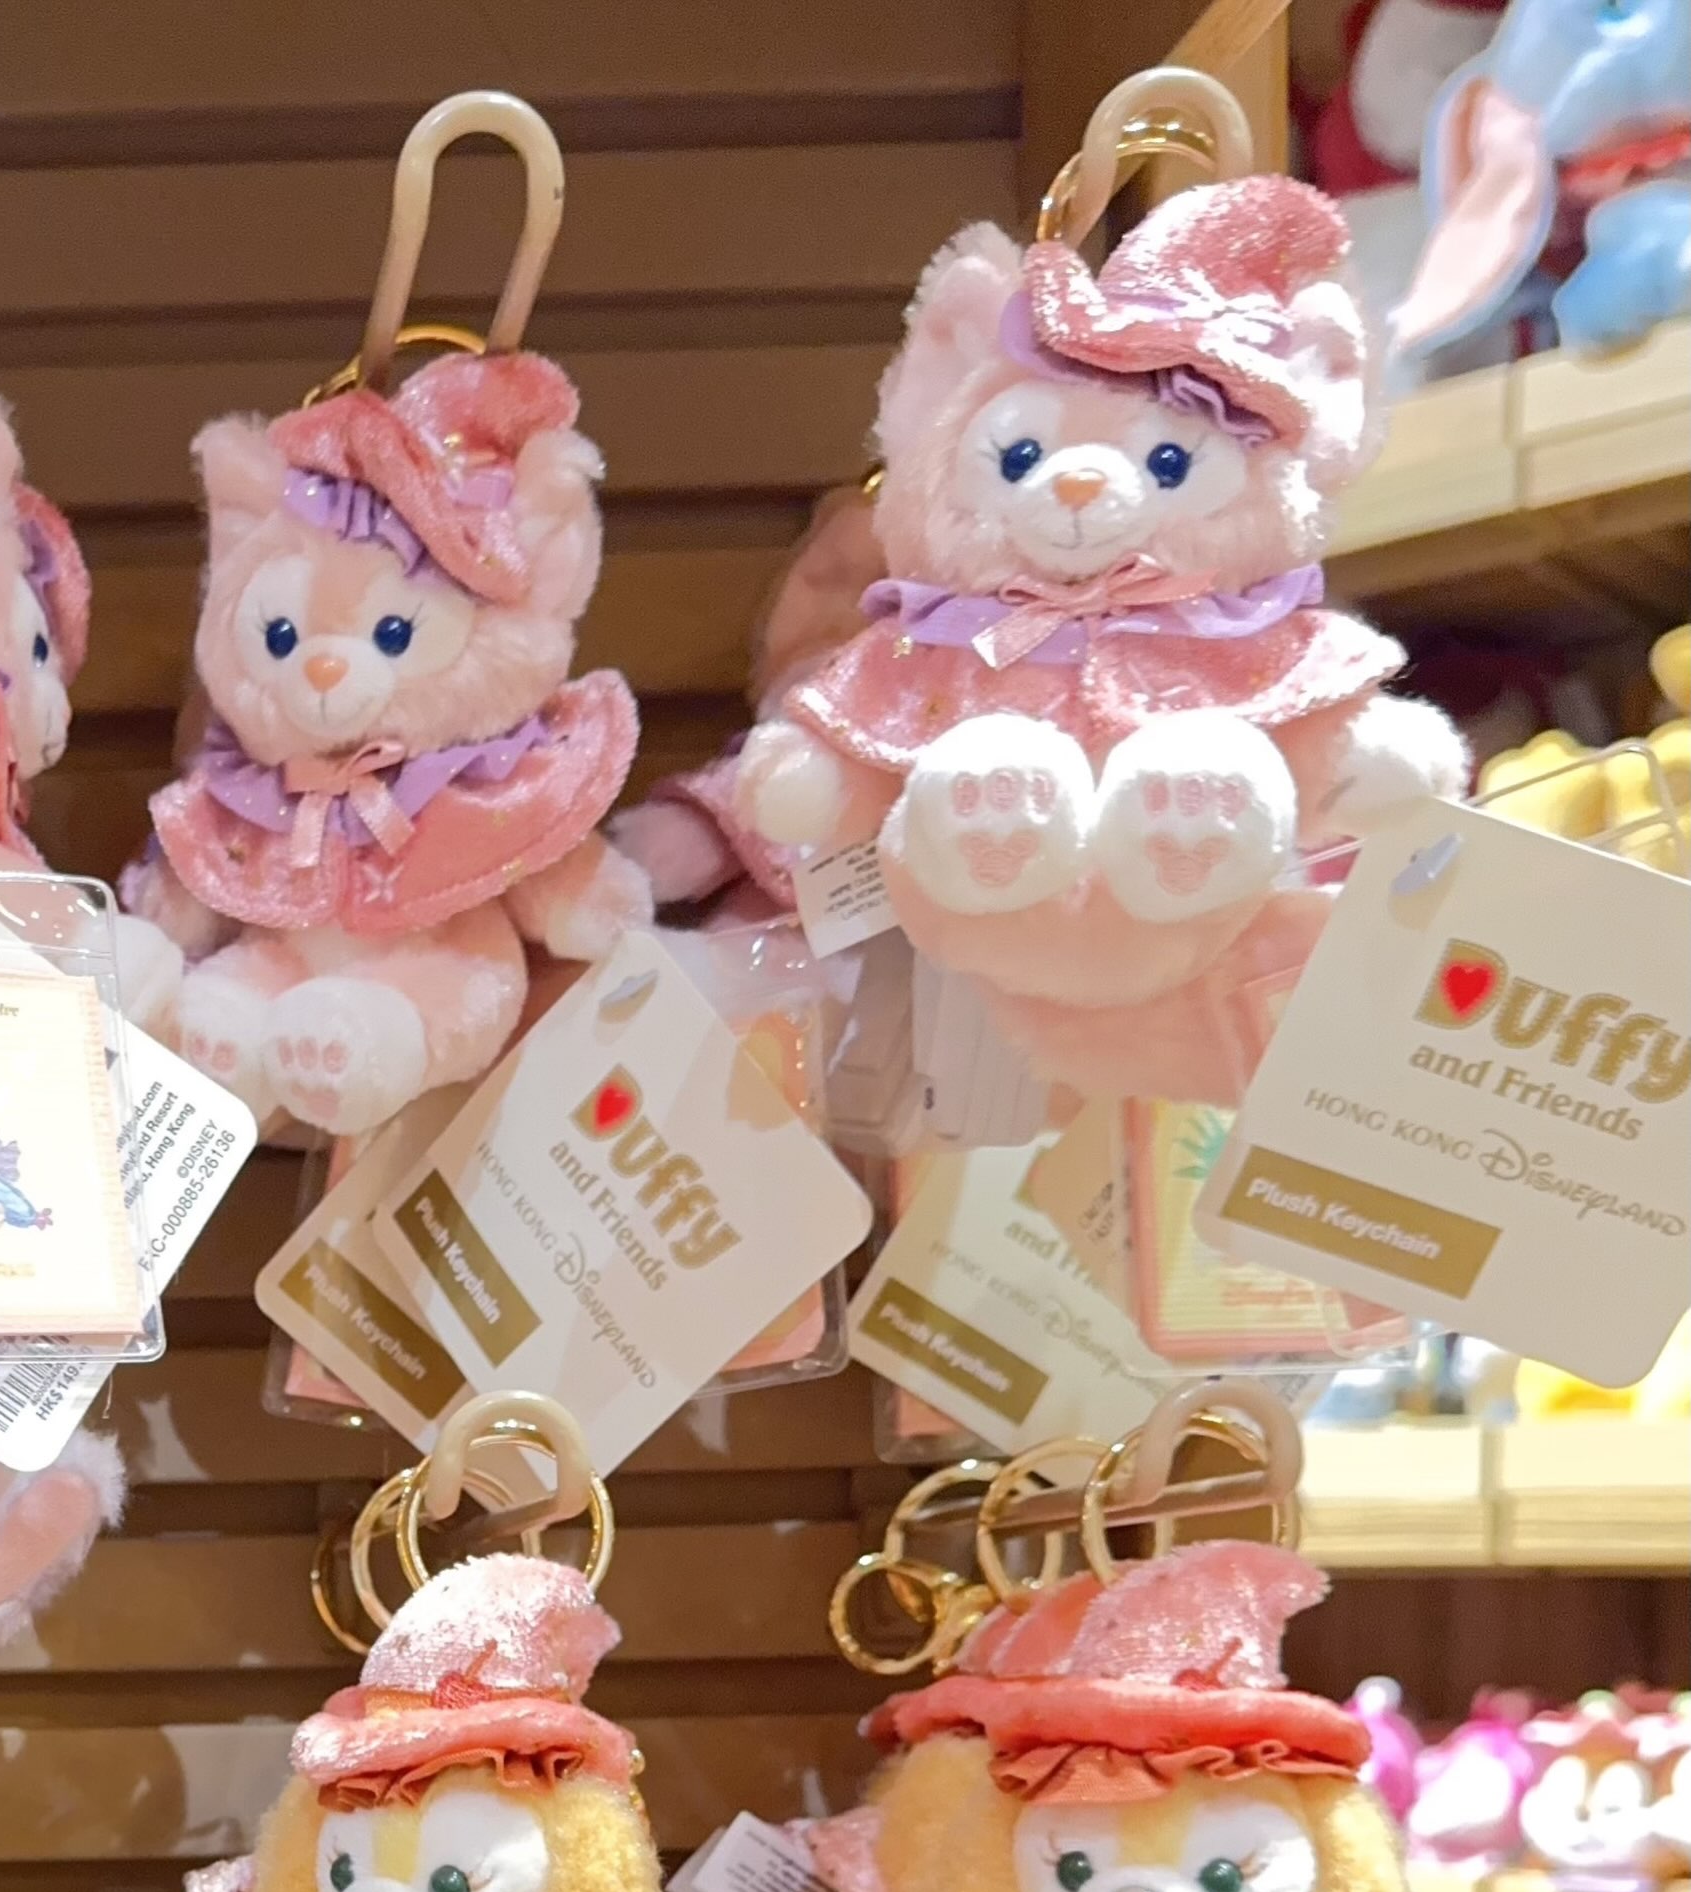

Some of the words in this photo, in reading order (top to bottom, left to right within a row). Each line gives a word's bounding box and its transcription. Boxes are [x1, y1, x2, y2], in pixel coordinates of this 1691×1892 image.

[1413, 937, 1691, 1105] Duffy
[145, 1135, 174, 1169] Hong
[167, 1103, 196, 1135] Kong
[146, 1091, 178, 1132] Resort
[1304, 1088, 1388, 1132] HONG
[1391, 1119, 1473, 1162] KONG
[1410, 1044, 1493, 1089] and
[1494, 1064, 1644, 1142] Friends
[477, 1142, 518, 1198] HONG
[512, 1196, 559, 1252] KONG
[549, 1141, 600, 1196] and
[589, 1188, 668, 1292] Friends
[569, 1062, 742, 1270] Duffy
[1245, 1176, 1322, 1219] Plush
[1321, 1204, 1443, 1261] Keychain
[414, 1195, 449, 1247] Plush
[444, 1242, 501, 1325] Keychain
[303, 1263, 352, 1313] Plush
[349, 1306, 427, 1381] Keychain
